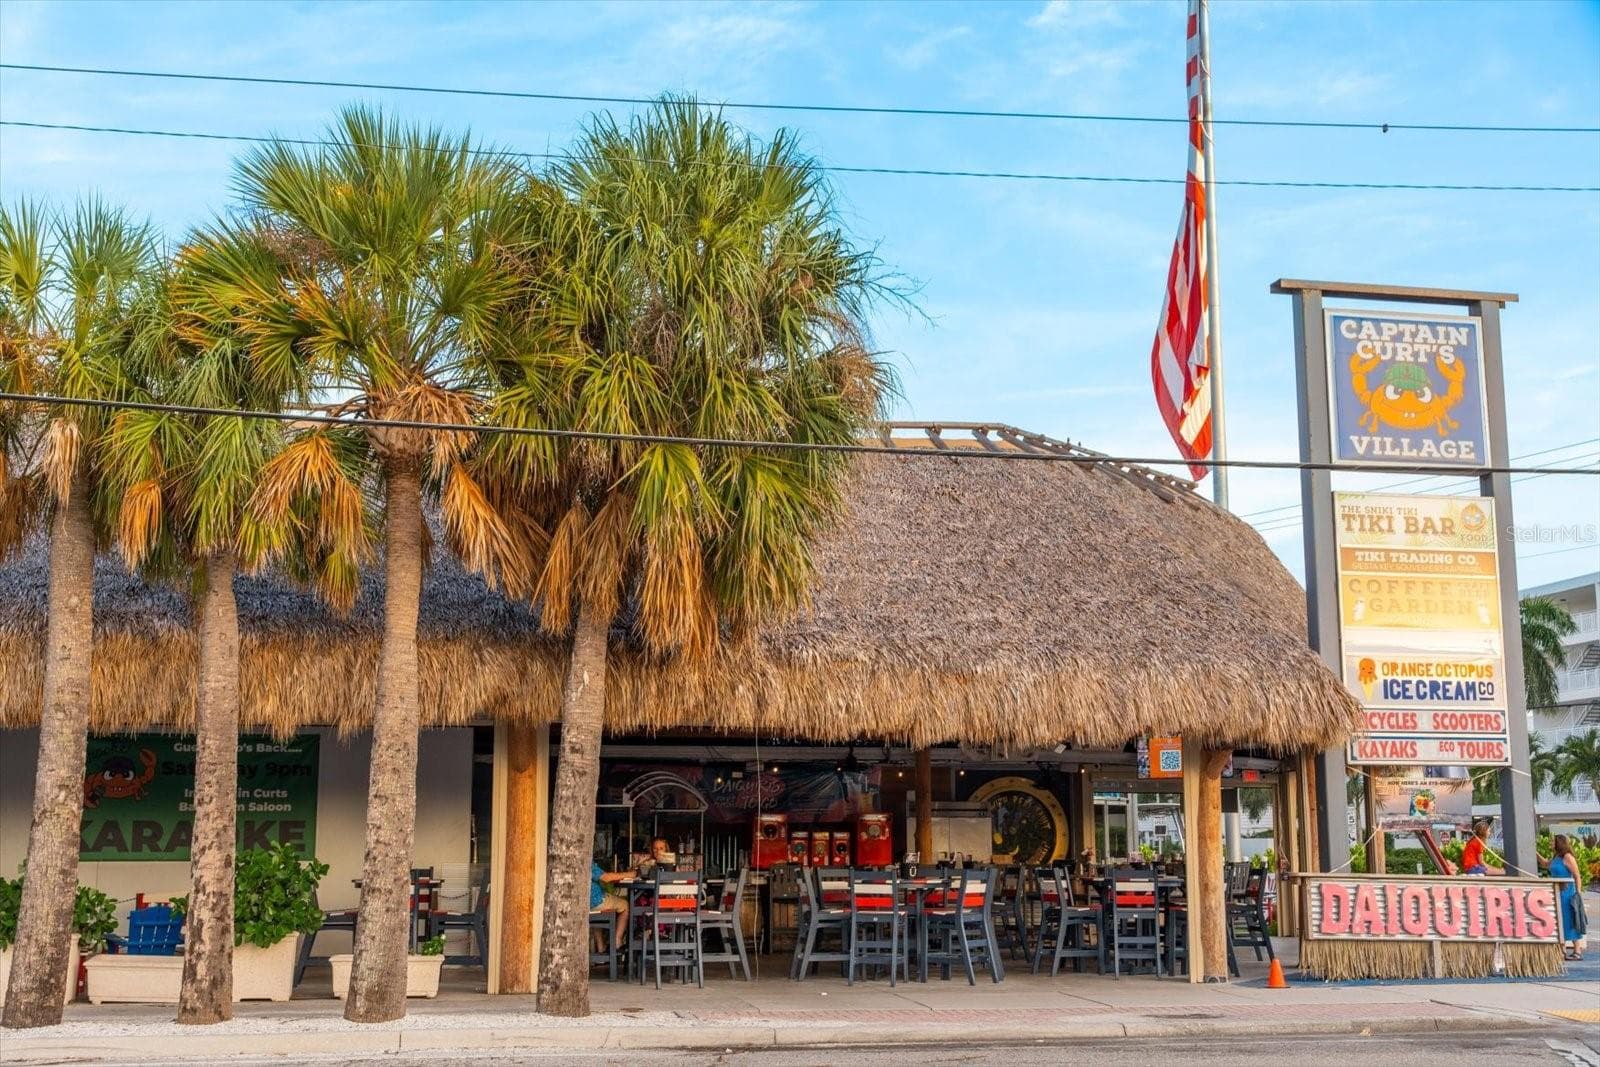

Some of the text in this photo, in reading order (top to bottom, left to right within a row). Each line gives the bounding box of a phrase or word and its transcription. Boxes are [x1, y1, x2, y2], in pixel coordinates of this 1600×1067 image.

[1340, 319, 1469, 346] CAPTAIN
[1356, 340, 1456, 364] CURT'S
[1349, 435, 1475, 459] VILLAGE
[1341, 505, 1361, 513] THE
[1397, 507, 1418, 516] TIKI
[1342, 513, 1456, 536] TIKI BAR
[1355, 551, 1480, 567] TIKI TRADING CO.
[1348, 578, 1451, 595] COFFEE
[1369, 599, 1473, 615] GARDEN
[1381, 661, 1494, 678] ORANGE OCTOPUS
[1383, 679, 1494, 701] ICE CREAM CO
[1359, 712, 1501, 731] ICYCLES SCOOTERS
[1358, 740, 1504, 760] KAYAKS ECO TOURS
[254, 788, 288, 798] Curts
[248, 802, 292, 812] Saloon
[1320, 882, 1555, 938] DAIQUIRIS
